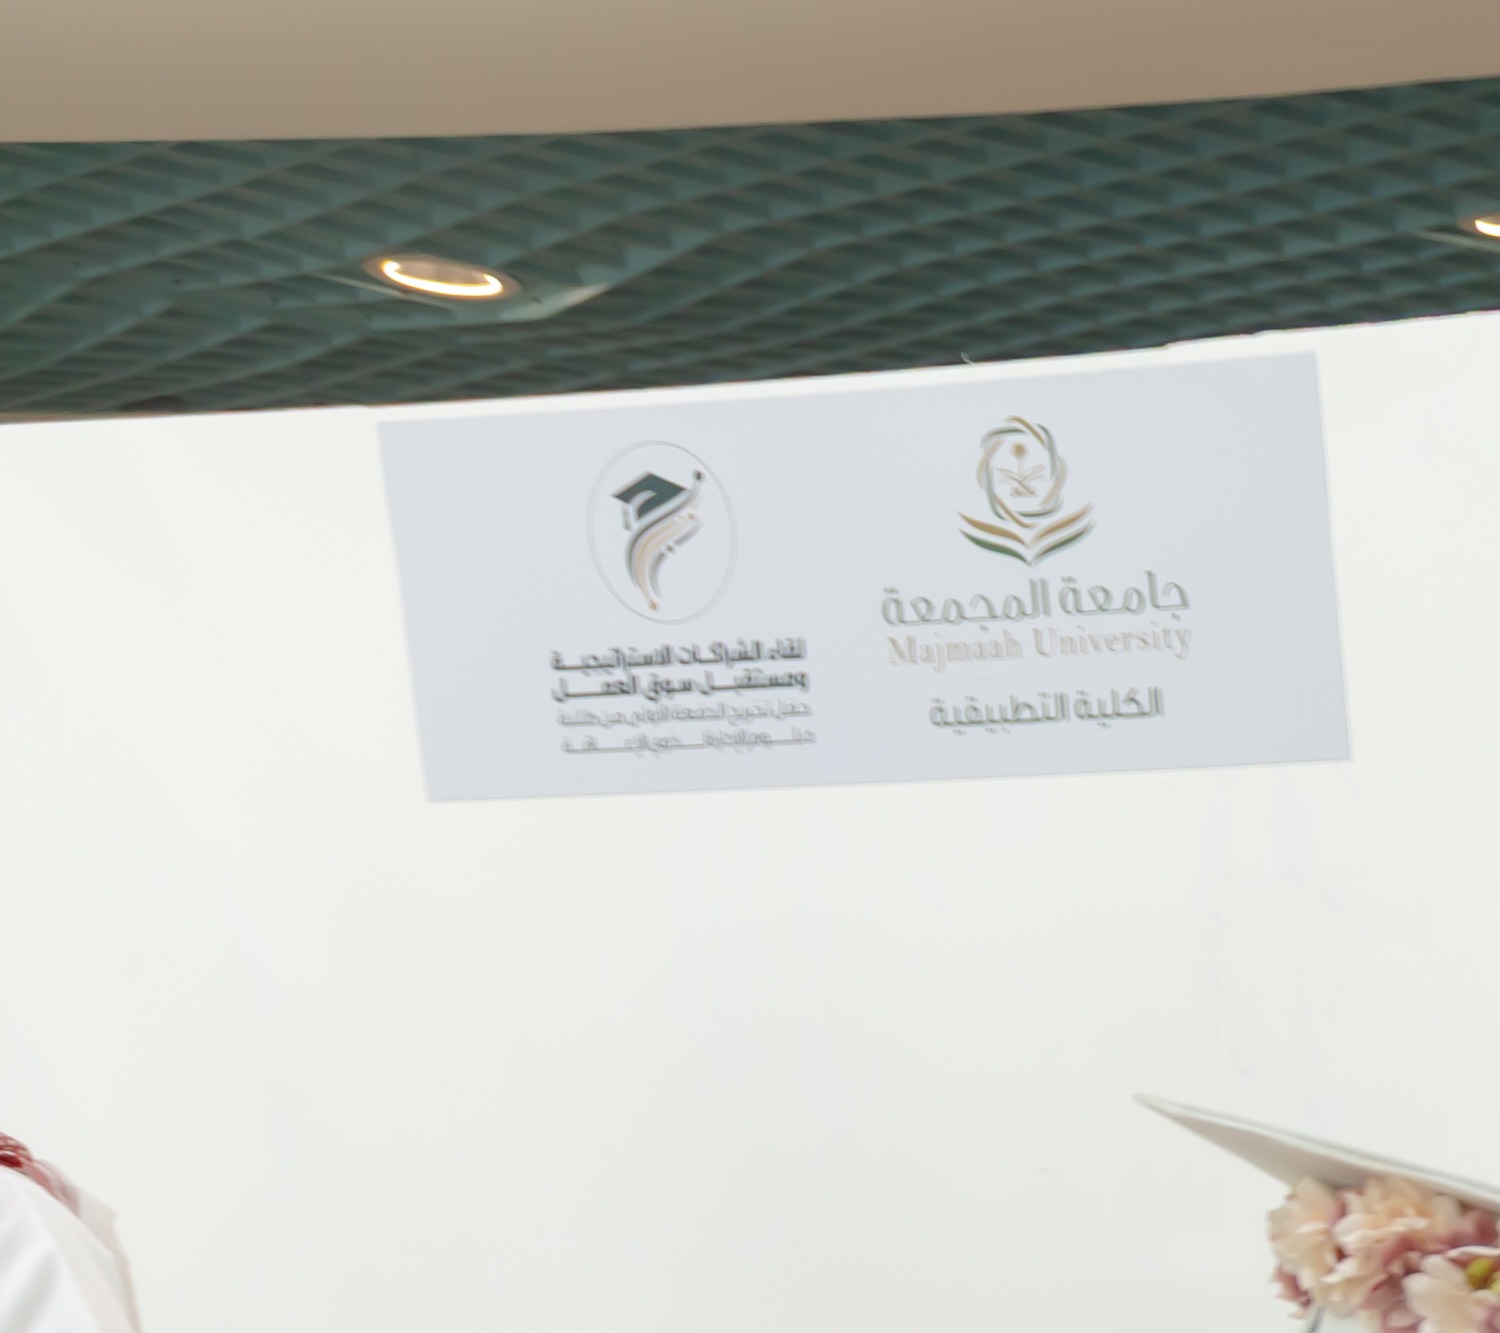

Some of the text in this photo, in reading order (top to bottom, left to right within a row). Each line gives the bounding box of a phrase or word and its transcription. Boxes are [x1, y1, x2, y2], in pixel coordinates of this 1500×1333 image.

[881, 570, 1191, 632] جامعة المجمعة
[887, 620, 1193, 673] Majmaah University
[928, 686, 1165, 736] الكلية التطبيقية
